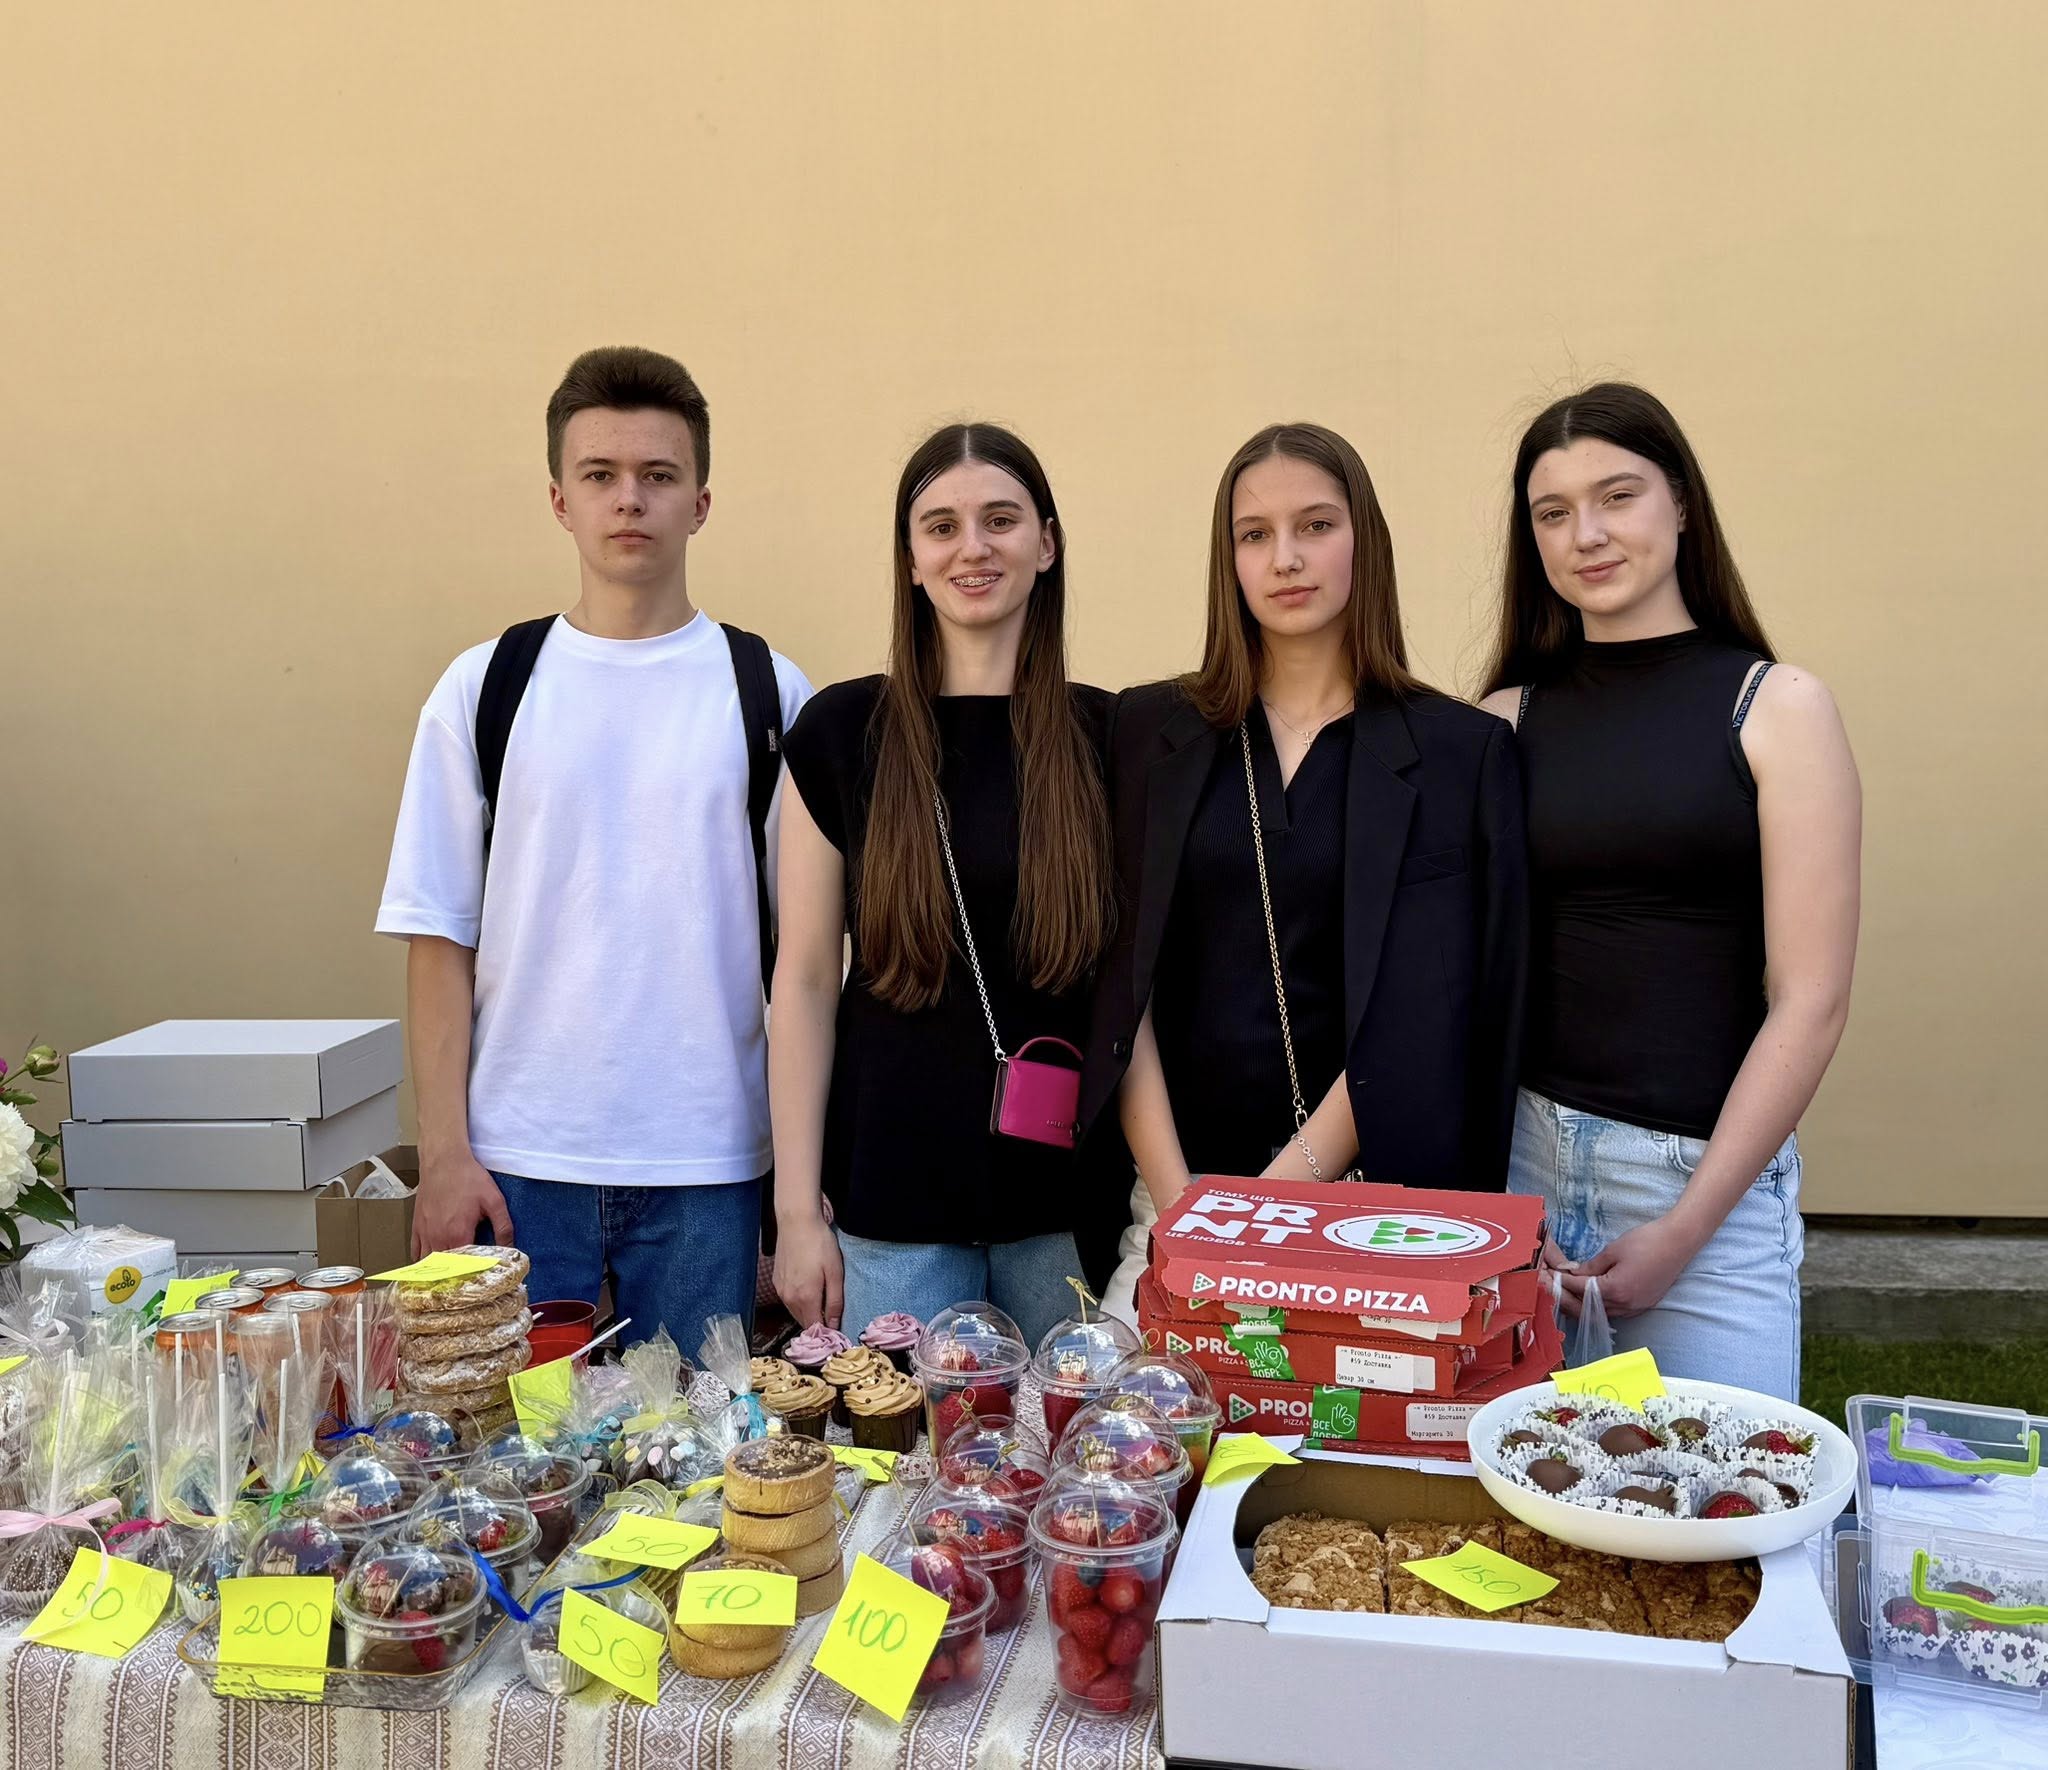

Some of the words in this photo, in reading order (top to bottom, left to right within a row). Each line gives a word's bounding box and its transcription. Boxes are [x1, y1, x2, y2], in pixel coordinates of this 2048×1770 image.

[1207, 1188, 1247, 1199] ТОМУ
[1249, 1194, 1276, 1203] ЩО
[1164, 1230, 1185, 1239] ЦЕ
[1187, 1233, 1247, 1247] ЛЮБОВ
[1218, 1276, 1338, 1305] PRONTO
[1343, 1286, 1431, 1315] PIZZA
[1218, 1356, 1239, 1366] PIZZA
[1249, 1357, 1266, 1369] ВСЕ
[1283, 1418, 1305, 1427] PIZZA
[1312, 1419, 1331, 1431] ВСЕ
[609, 1535, 689, 1557] 50
[1450, 1563, 1522, 1595] 150
[61, 1581, 124, 1621] 50
[695, 1584, 762, 1610] 70
[233, 1600, 322, 1637] 200
[843, 1599, 909, 1652] 100
[572, 1614, 648, 1679] 50
